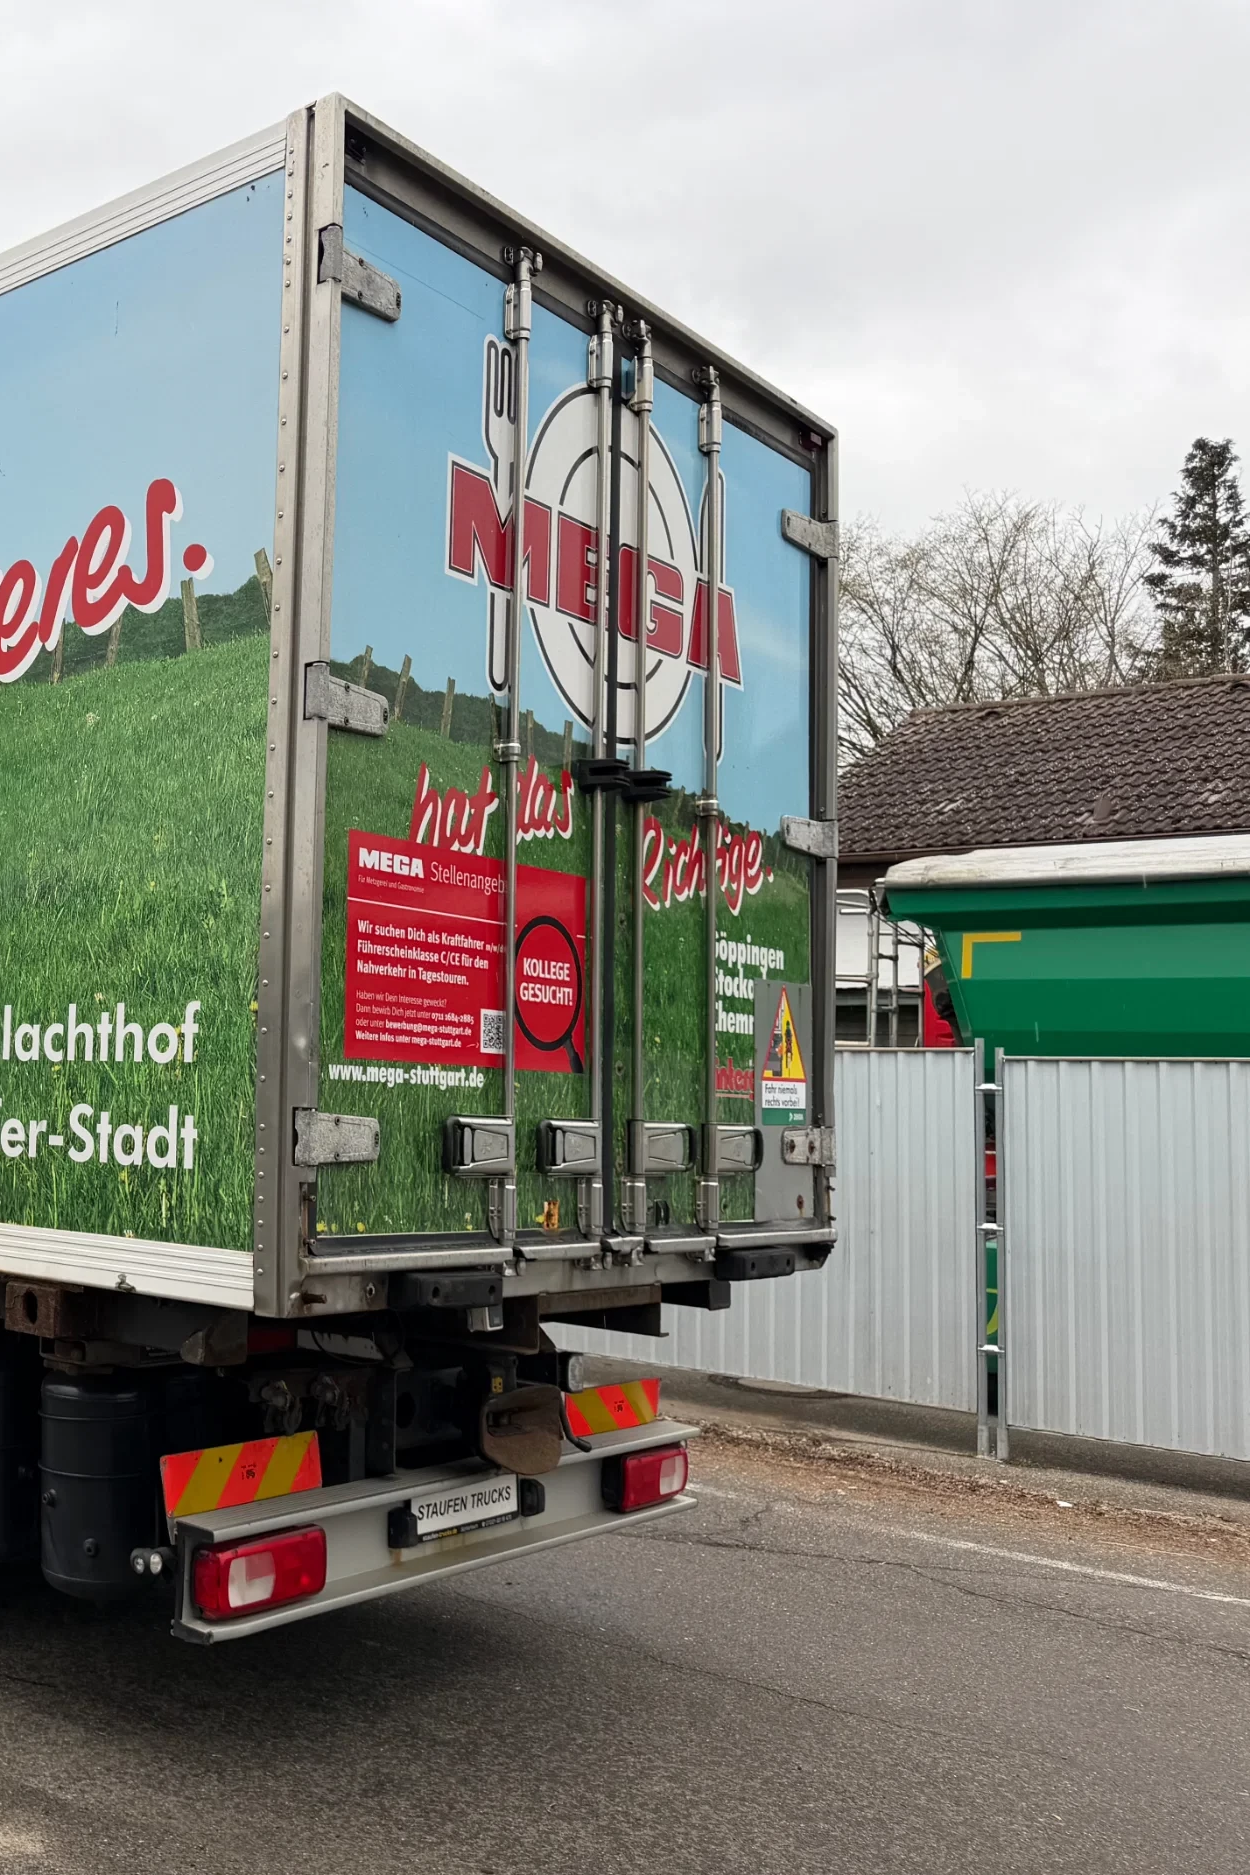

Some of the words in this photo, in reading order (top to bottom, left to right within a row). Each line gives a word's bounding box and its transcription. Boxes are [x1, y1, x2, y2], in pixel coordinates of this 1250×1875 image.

[447, 454, 743, 688] MEGA
[409, 761, 498, 855] hat
[358, 847, 424, 878] MEGA
[430, 861, 507, 895] Stellenangeb
[357, 919, 373, 934] Wir
[374, 924, 405, 939] suchen
[407, 927, 425, 941] Dich
[427, 930, 440, 944] als
[441, 932, 484, 950] Kraftfahrer
[357, 939, 439, 963] Führerscheinklasse
[440, 951, 460, 967] C/CE
[461, 953, 473, 968] für
[474, 956, 489, 969] den
[356, 959, 406, 978] Nahverkehr
[408, 965, 416, 979] in
[417, 967, 469, 986] Tagestouren.
[523, 957, 571, 981] KOLLEGE
[356, 990, 375, 1000] Haben
[376, 992, 384, 1000] wir
[385, 992, 398, 1002] Dein
[398, 994, 422, 1005] Interesse
[423, 998, 447, 1008] geweckt?
[519, 982, 573, 1006] GESUCHT!
[355, 1003, 371, 1013] Dann
[372, 1004, 390, 1014] bewirb
[391, 1006, 404, 1016] Dich
[404, 1009, 416, 1019] jetzt
[417, 1011, 431, 1019] unter
[355, 1018, 369, 1026] oder
[370, 1020, 384, 1028] unter
[715, 1000, 754, 1034] hem
[355, 1030, 378, 1041] Weitere
[379, 1032, 394, 1042] Infos
[395, 1034, 410, 1043] unter
[329, 1064, 484, 1090] www.mega-stuttgart.de
[417, 1496, 468, 1520] STAUFEN
[471, 1485, 512, 1509] TRUCKS
